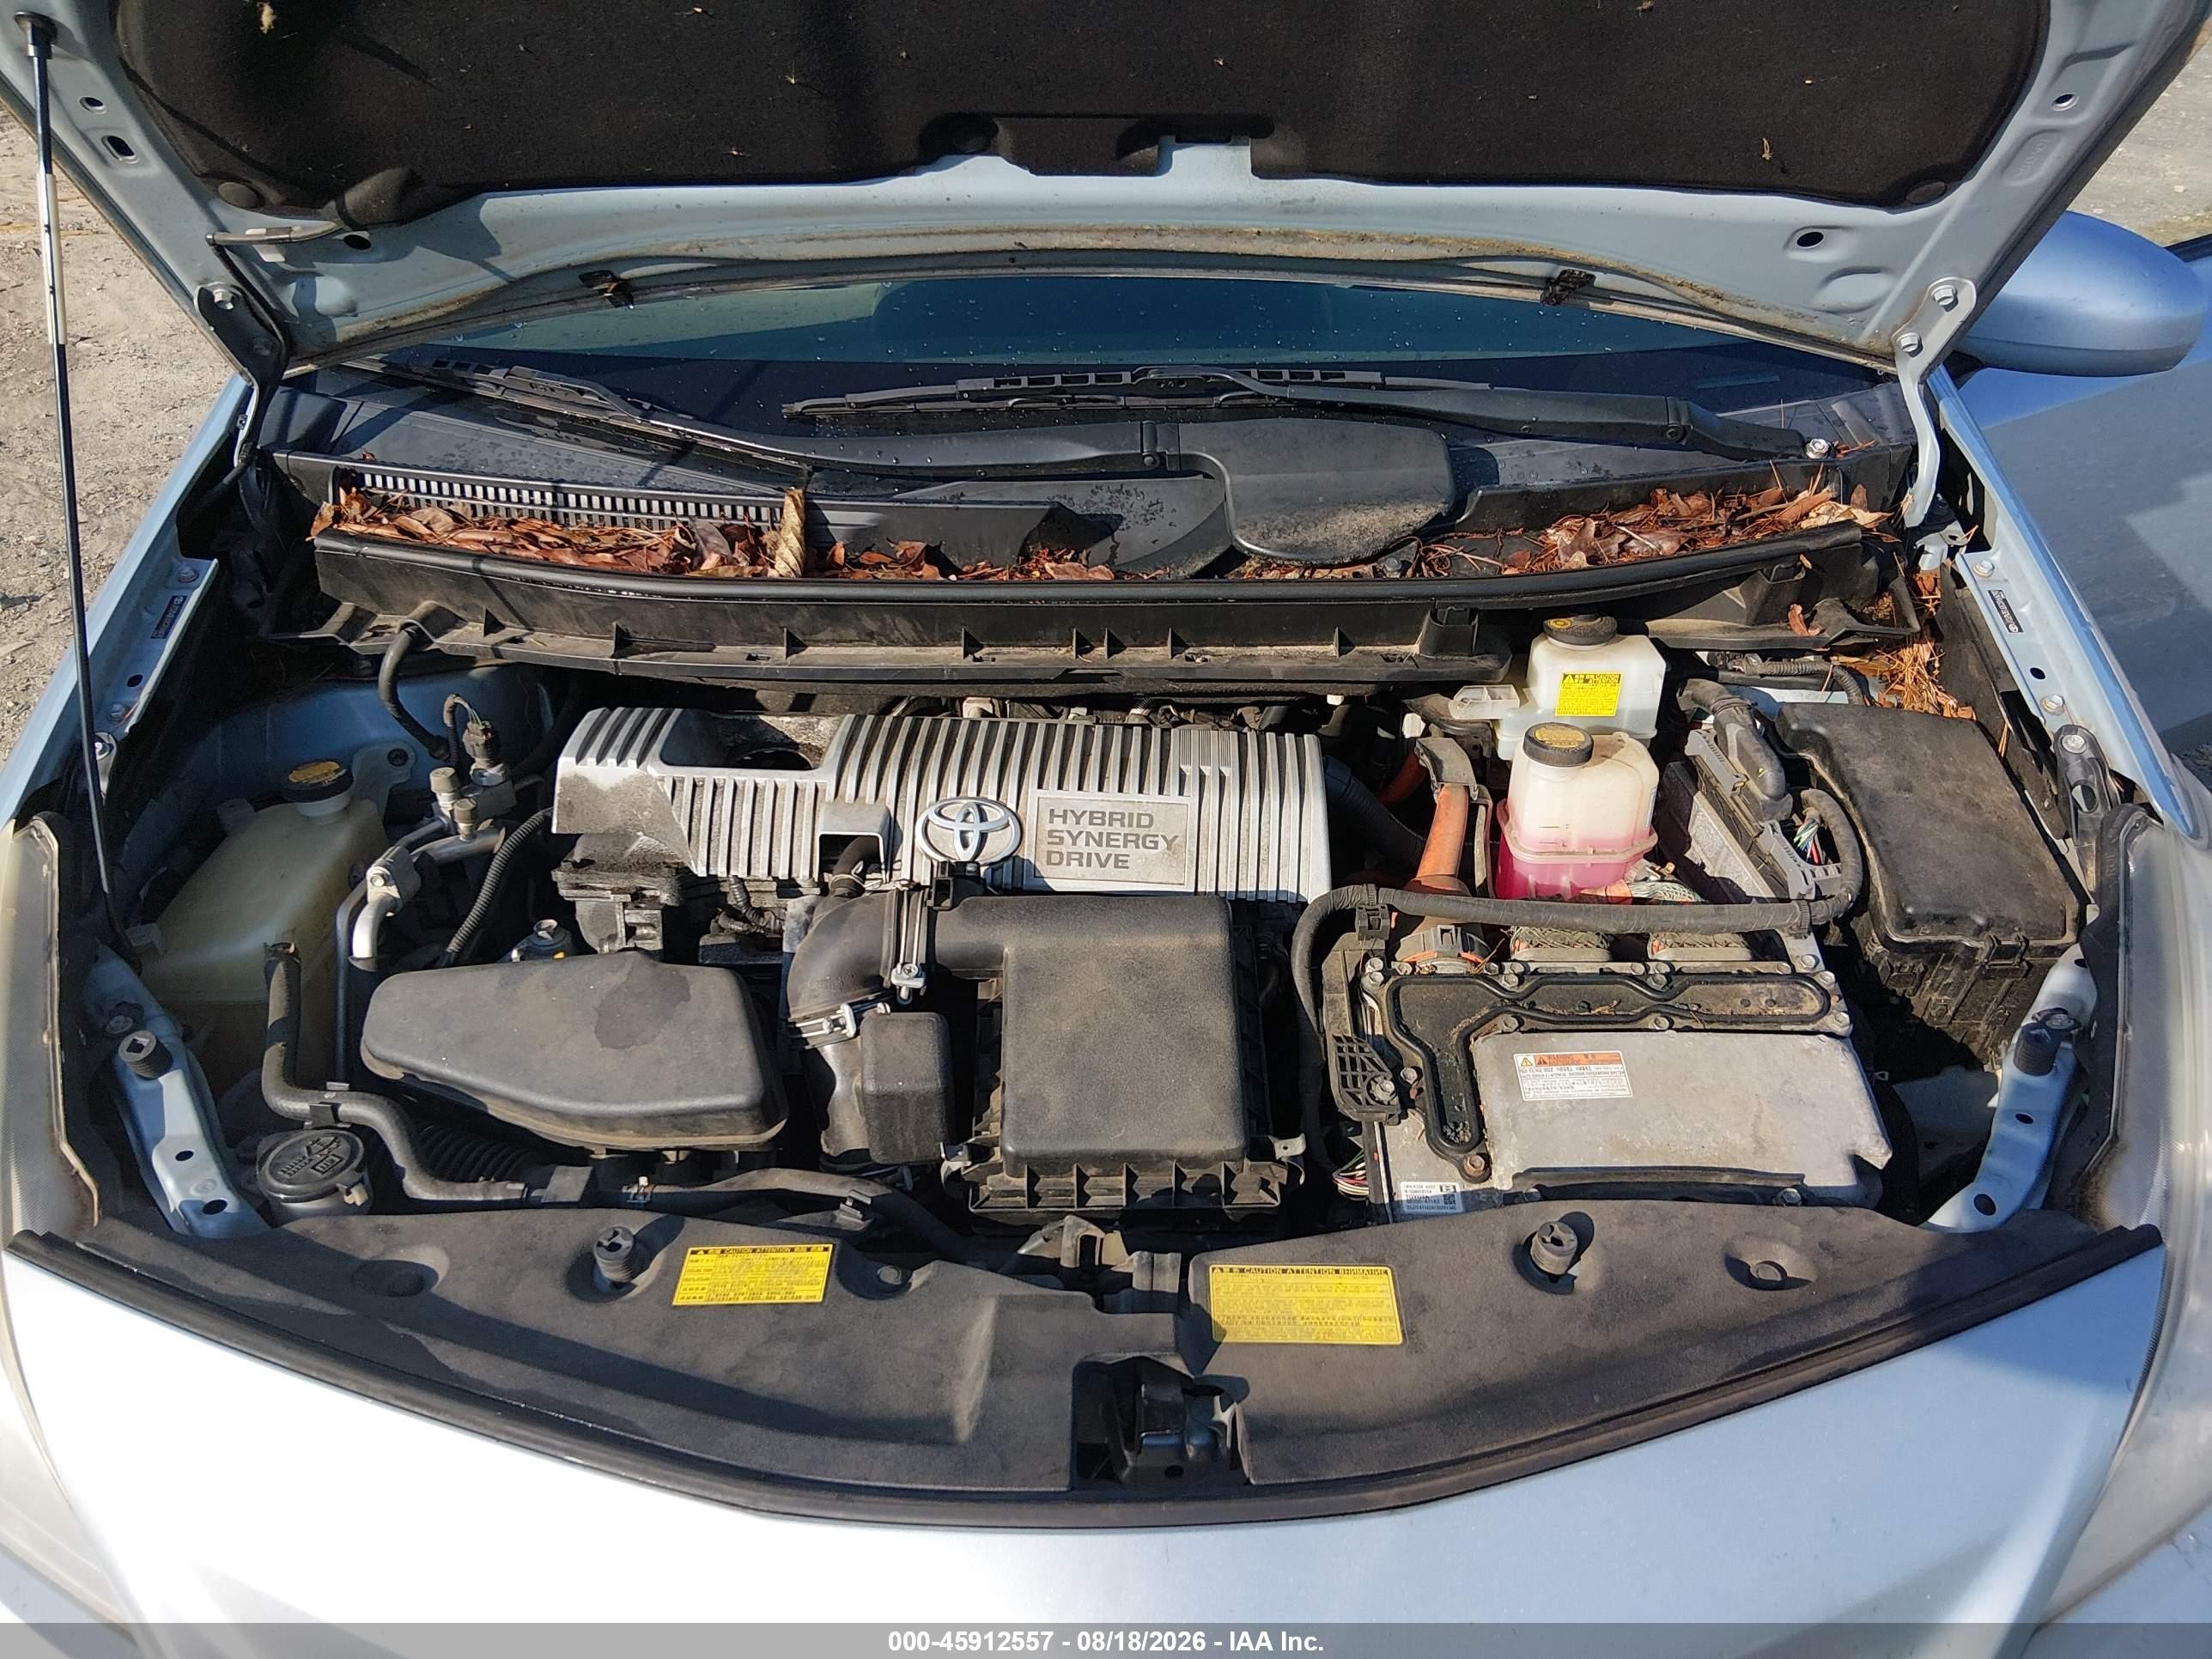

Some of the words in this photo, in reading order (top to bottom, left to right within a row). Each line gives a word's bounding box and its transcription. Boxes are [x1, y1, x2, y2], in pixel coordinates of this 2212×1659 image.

[1048, 808, 1154, 829] HYBRID
[1047, 830, 1179, 851] SYNERGY
[1046, 851, 1130, 870] DRIVE
